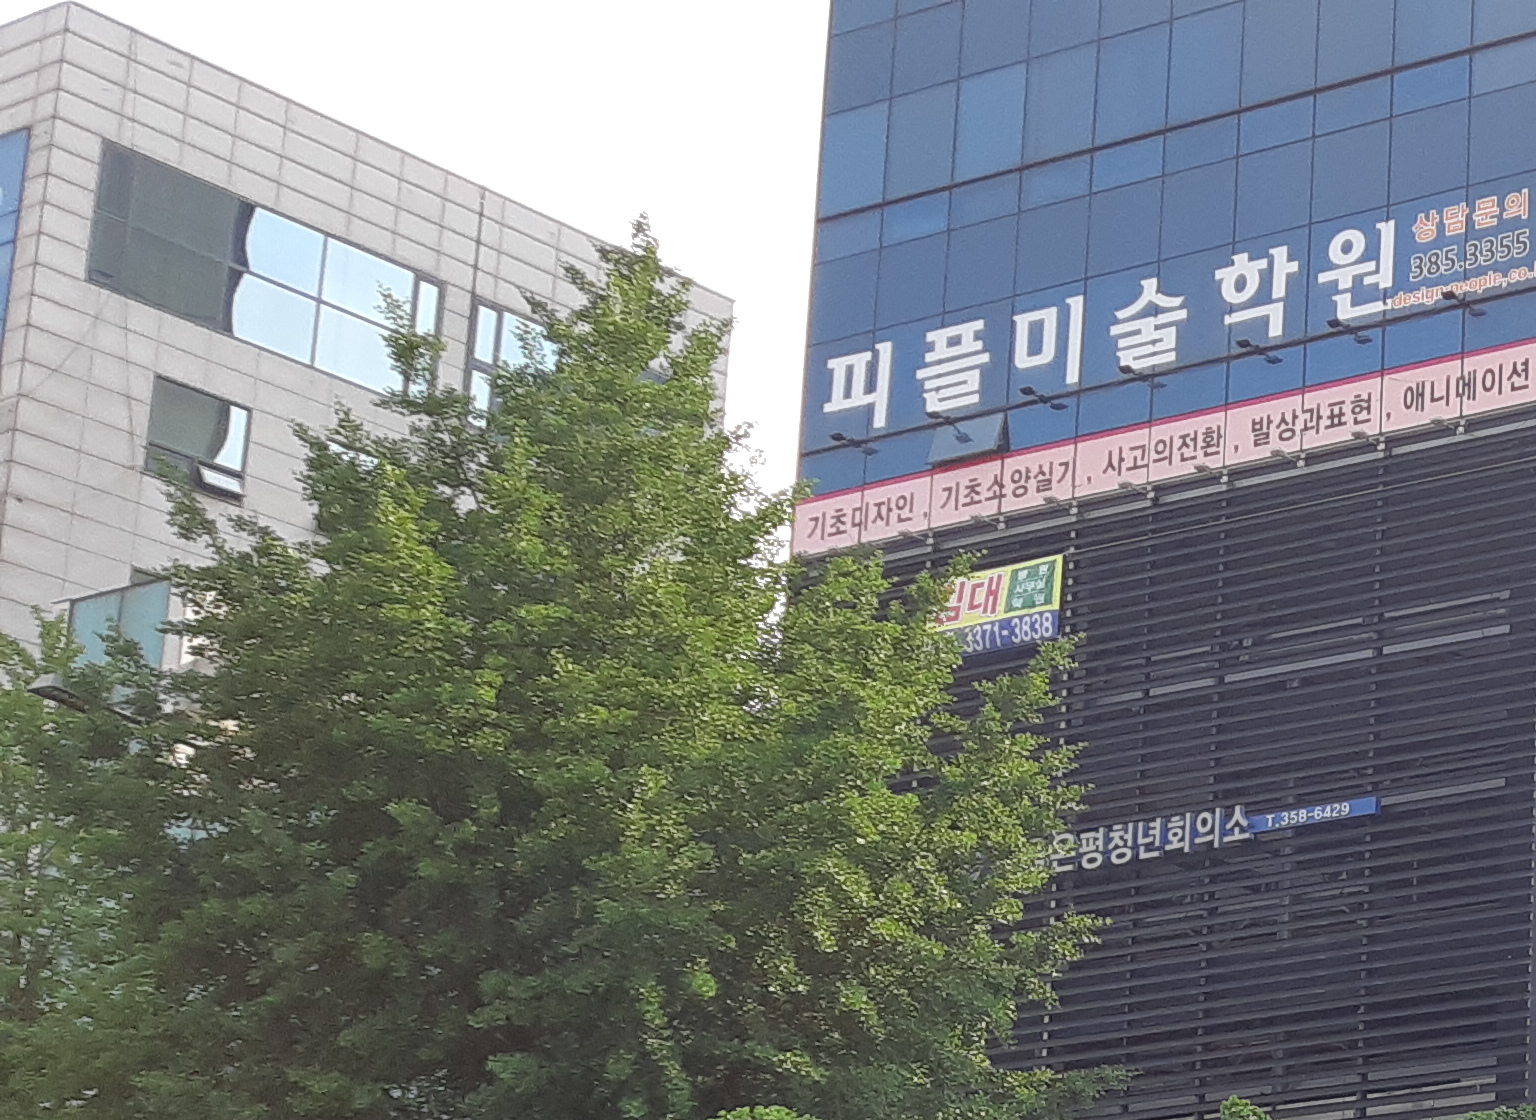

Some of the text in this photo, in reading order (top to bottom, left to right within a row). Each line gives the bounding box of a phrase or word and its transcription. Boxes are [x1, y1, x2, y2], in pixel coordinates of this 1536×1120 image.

[1411, 187, 1531, 244] 상담문의
[1408, 228, 1531, 283] 385.3355
[822, 219, 1397, 430] 피플미술학원
[1403, 357, 1532, 413] 애니메이션
[1265, 802, 1351, 829] T.358-6429
